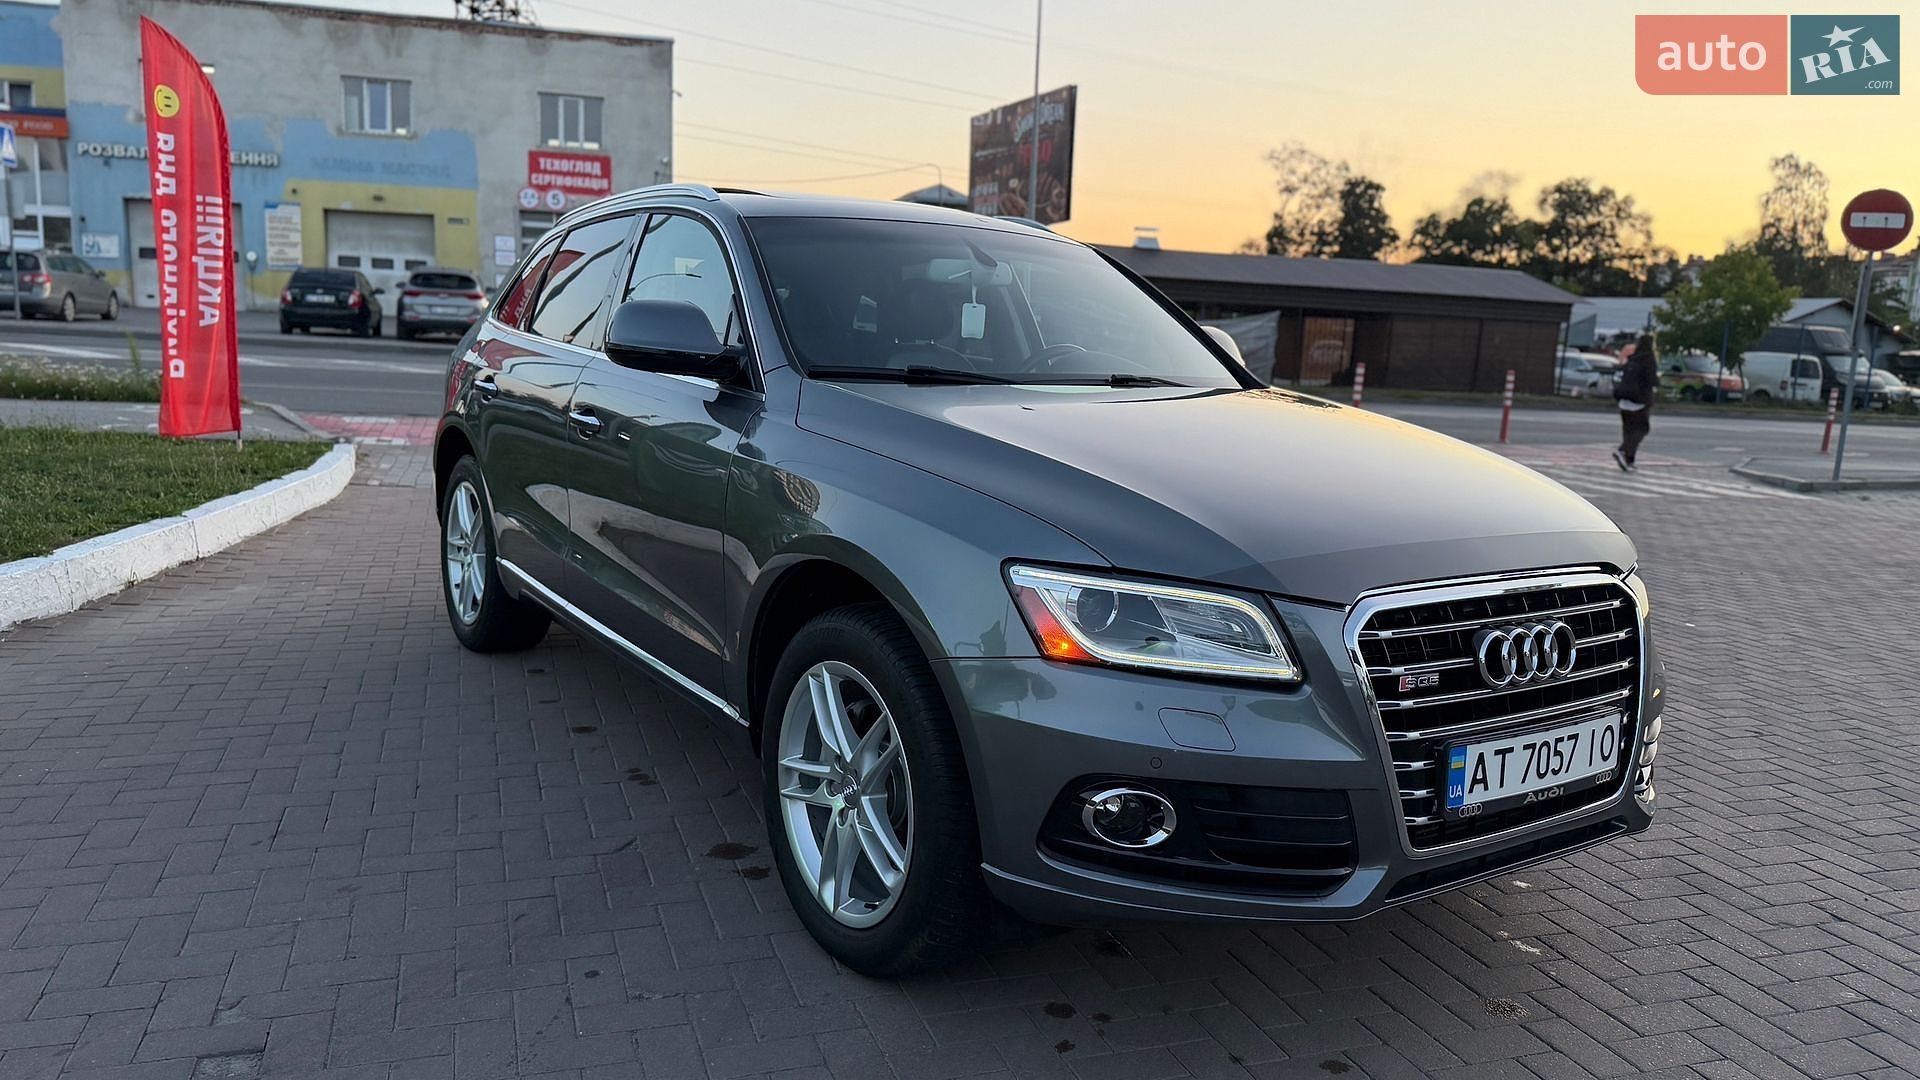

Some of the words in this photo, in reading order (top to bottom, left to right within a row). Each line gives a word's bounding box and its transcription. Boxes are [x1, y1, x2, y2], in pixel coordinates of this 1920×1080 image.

[538, 157, 602, 177] ТЕХОГЛЯД
[1521, 734, 1580, 784] 7057
[1449, 785, 1463, 798] UA
[1523, 786, 1564, 804] Audi
